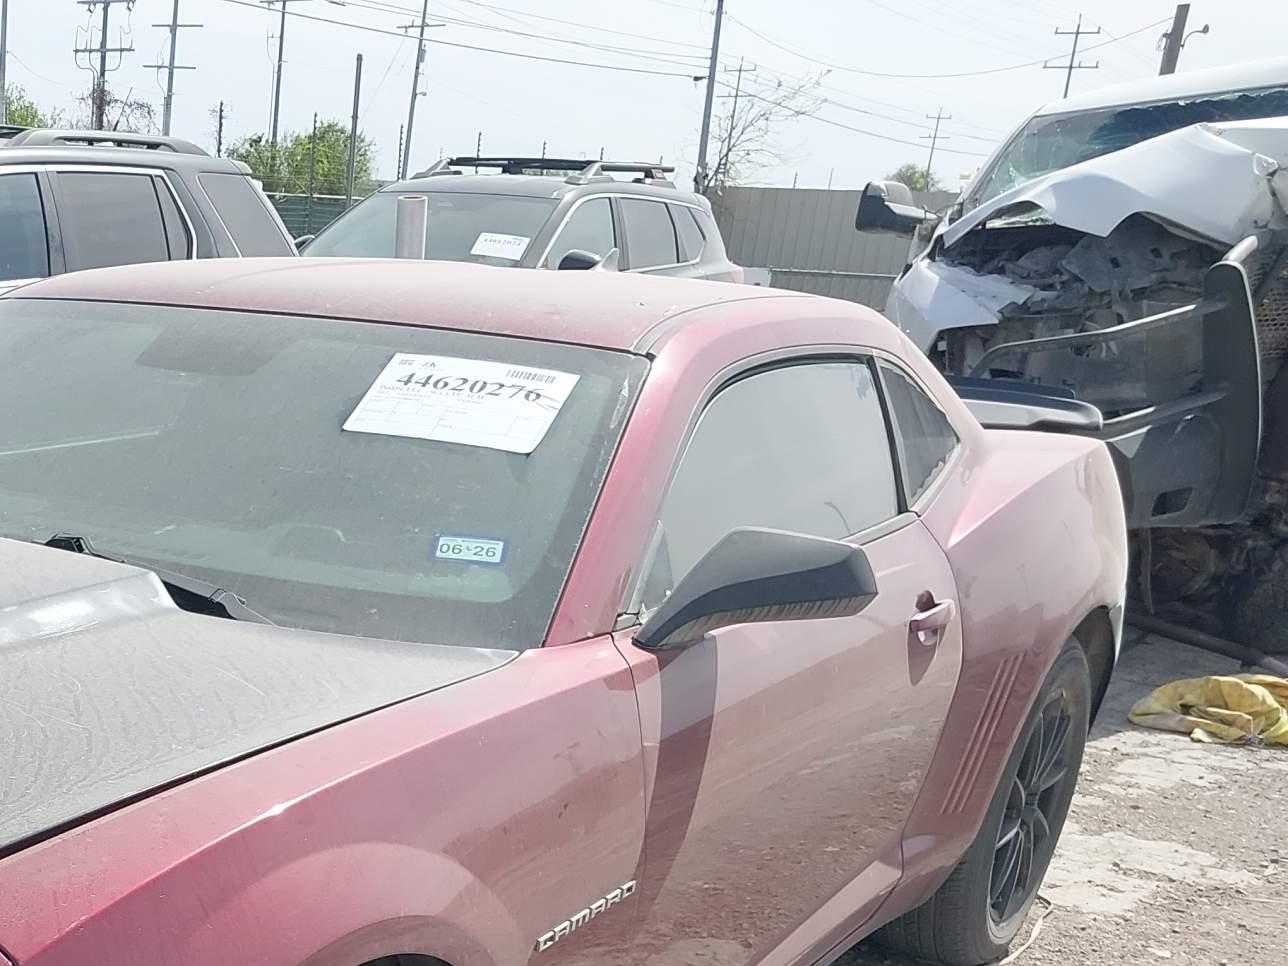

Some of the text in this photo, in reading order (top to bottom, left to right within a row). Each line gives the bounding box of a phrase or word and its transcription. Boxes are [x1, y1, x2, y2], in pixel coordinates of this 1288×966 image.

[396, 371, 545, 403] 44620276
[439, 543, 497, 558] 06 26
[536, 879, 637, 953] CAMARO
